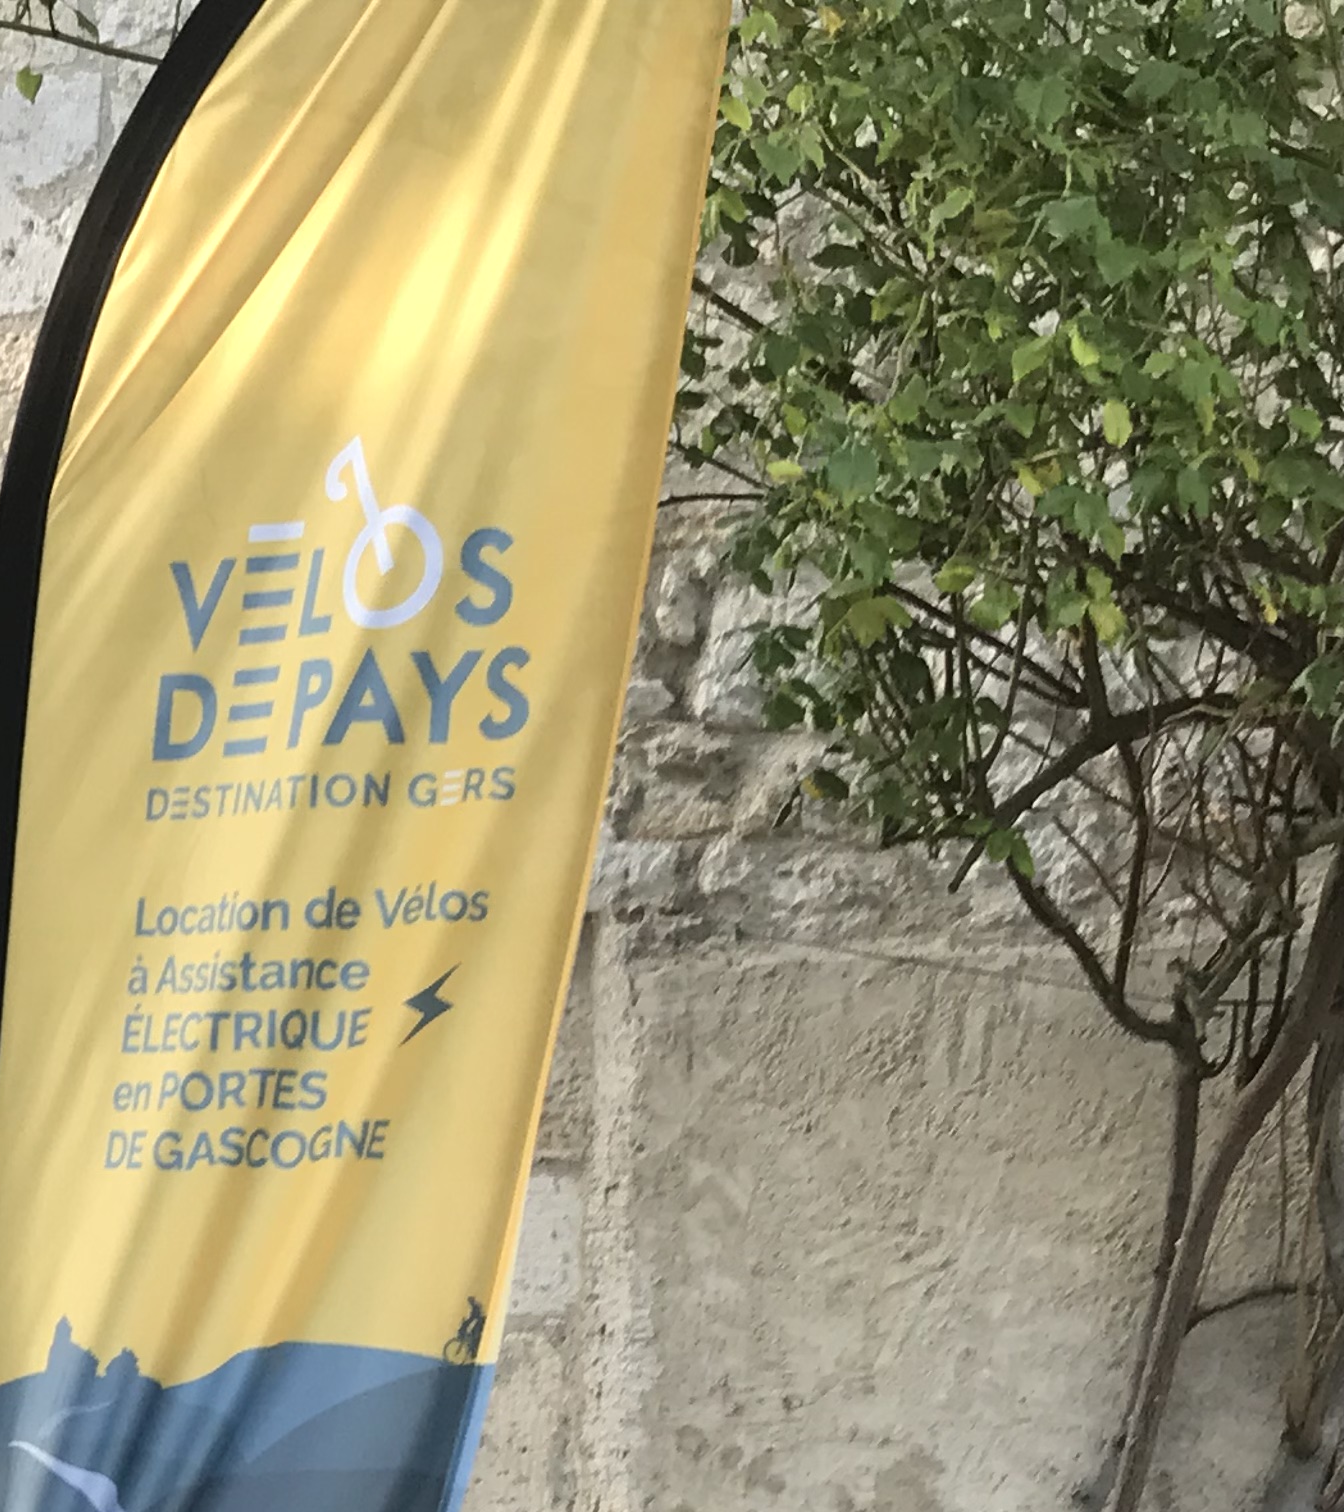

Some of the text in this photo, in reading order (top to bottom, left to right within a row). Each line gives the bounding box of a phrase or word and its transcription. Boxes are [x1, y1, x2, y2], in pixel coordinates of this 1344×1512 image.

[145, 766, 517, 822] DESTINATION GERS
[134, 880, 490, 938] Location de Vélos
[127, 949, 372, 996] à Assistance
[120, 1003, 373, 1055] ÉLECTRIQUE
[111, 1068, 329, 1113] en PORTES
[103, 1118, 392, 1172] DE GASCOGNE
